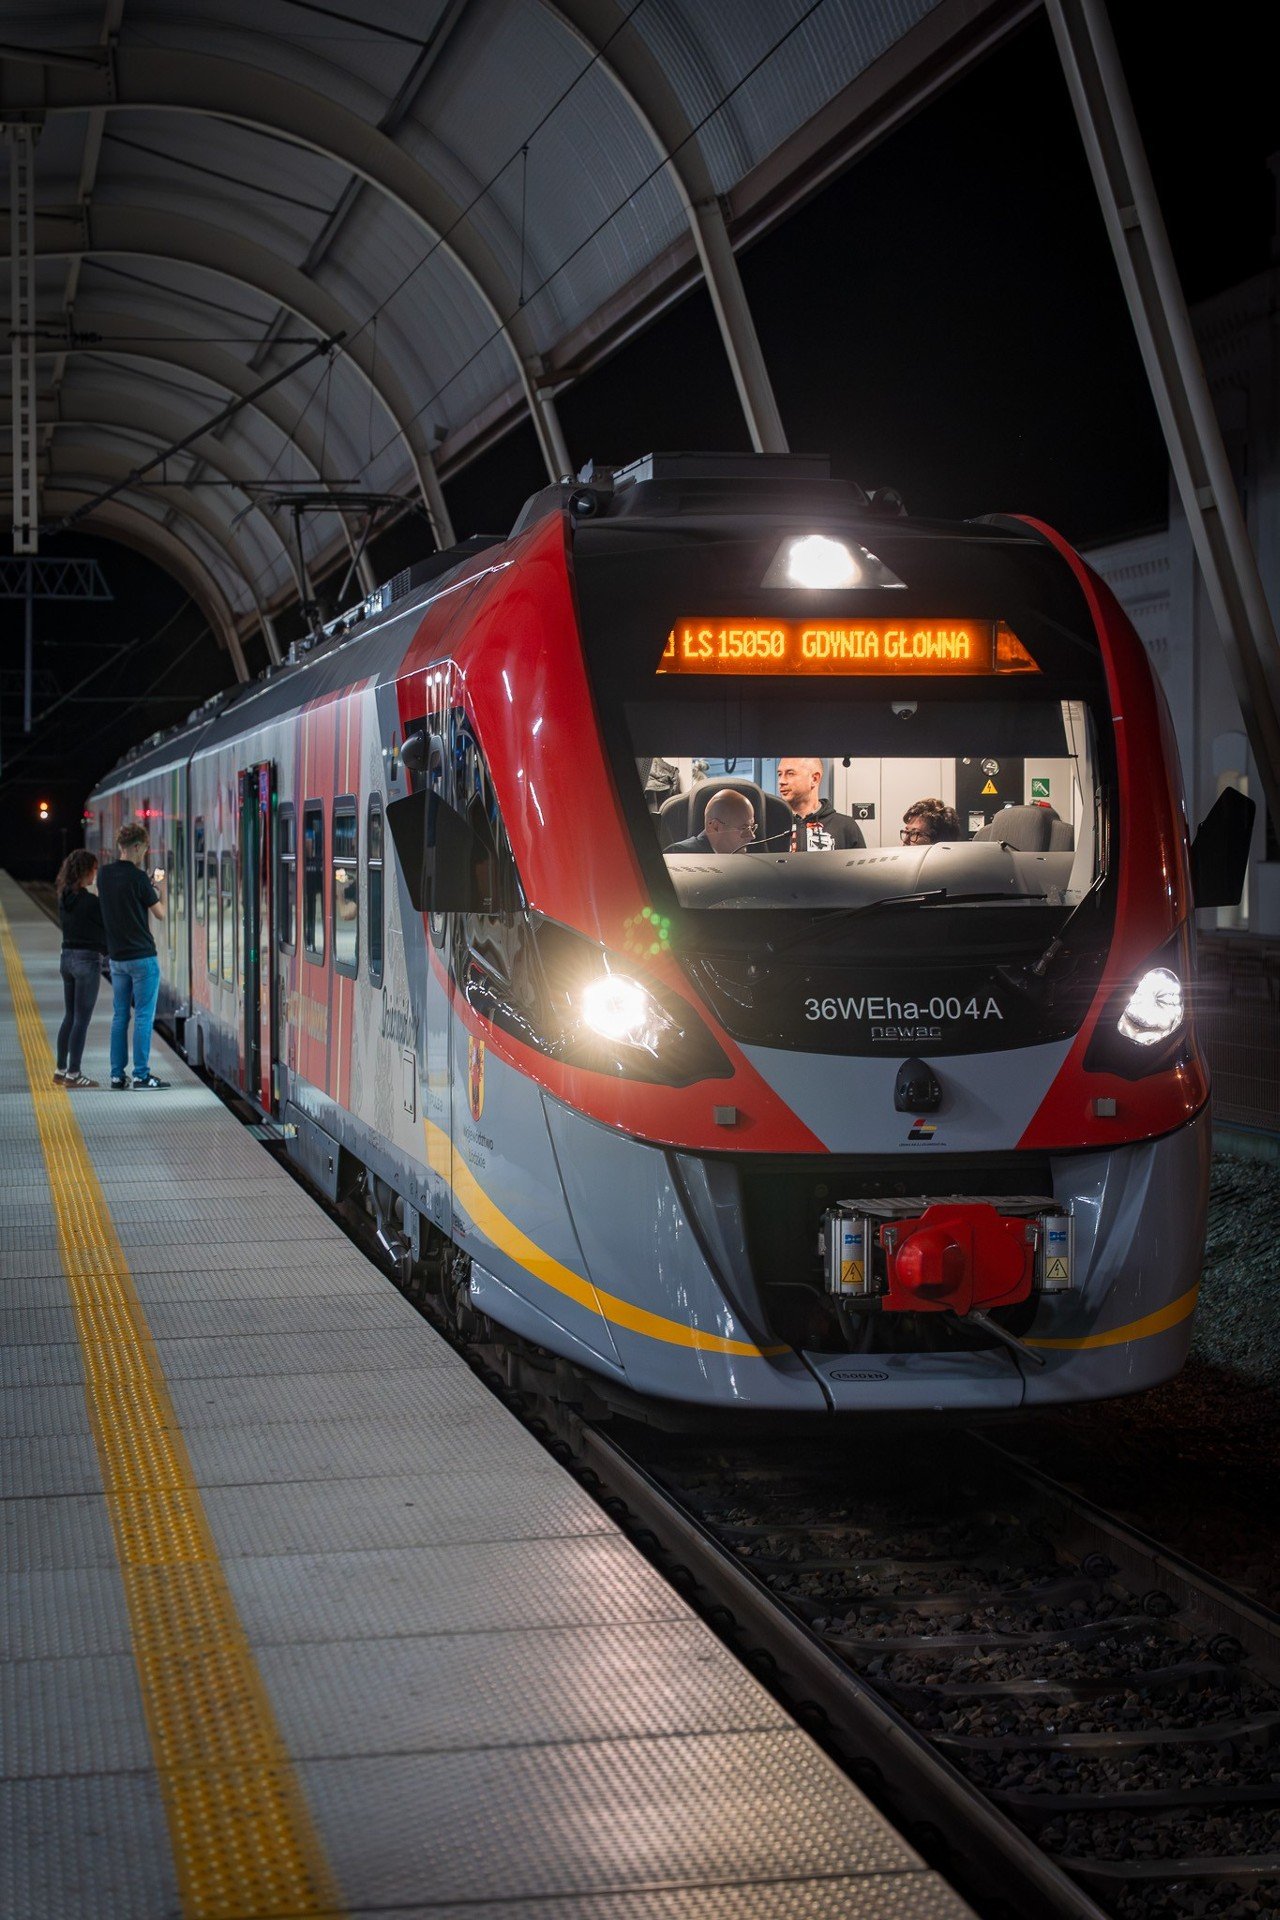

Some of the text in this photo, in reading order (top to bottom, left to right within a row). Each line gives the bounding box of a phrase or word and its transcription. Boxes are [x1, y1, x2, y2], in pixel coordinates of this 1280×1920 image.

[683, 630, 713, 658] ŁS
[718, 630, 785, 658] 15050
[802, 630, 879, 658] GDYNIA
[805, 997, 1004, 1020] 36WEha-004A
